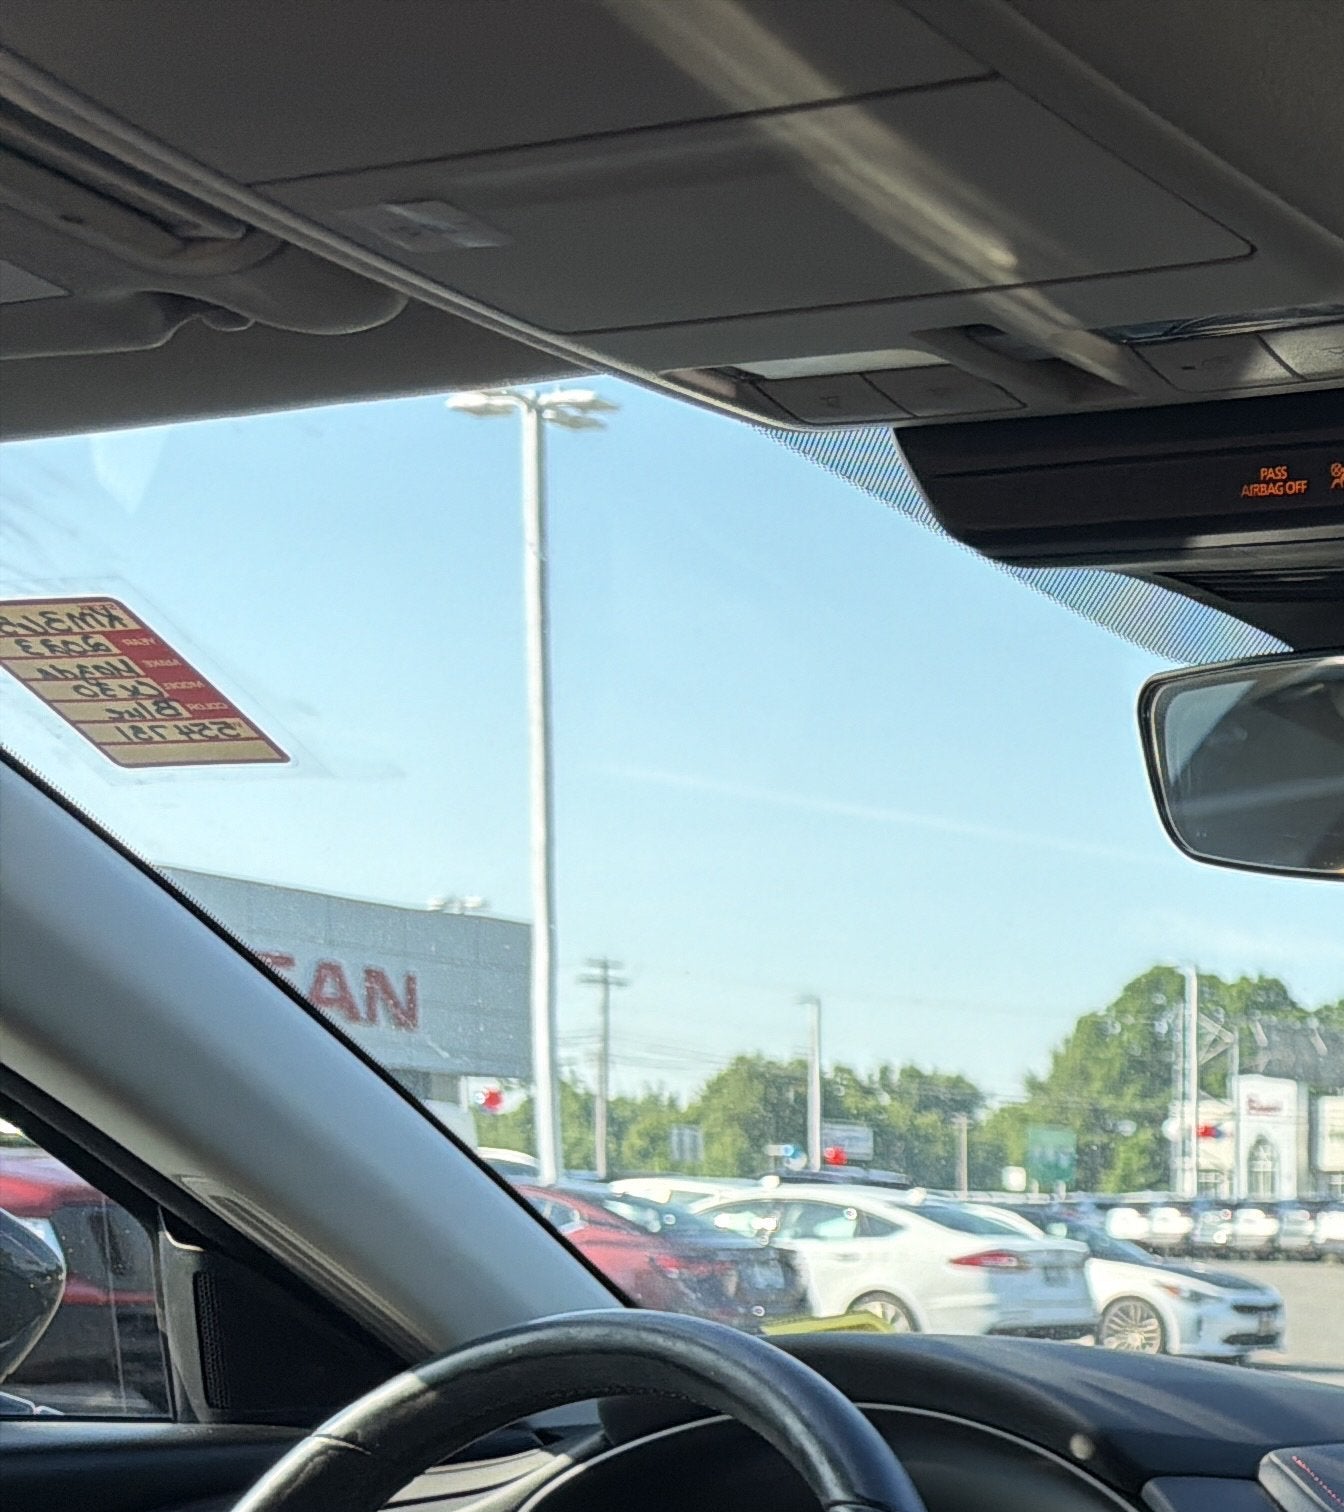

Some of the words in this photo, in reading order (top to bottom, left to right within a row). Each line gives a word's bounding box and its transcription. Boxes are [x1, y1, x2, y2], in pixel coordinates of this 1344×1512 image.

[1260, 465, 1288, 480] PASS
[1241, 482, 1284, 498] AIRBAG
[1285, 480, 1308, 495] OFF
